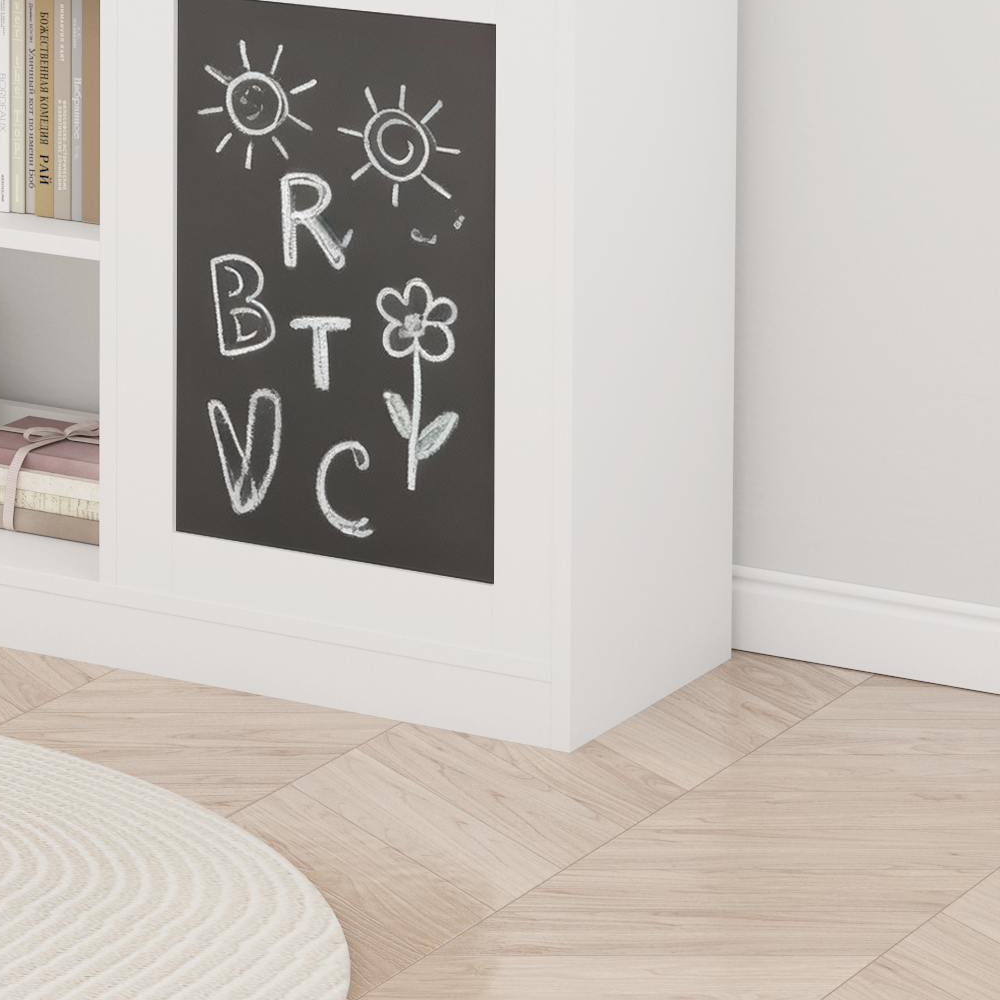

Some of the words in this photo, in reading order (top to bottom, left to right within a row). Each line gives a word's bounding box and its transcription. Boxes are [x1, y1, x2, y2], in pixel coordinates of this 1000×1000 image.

[39, 11, 49, 93] БОЖЕСТВЕННАЯ
[0, 72, 7, 132] BORDEAUX
[29, 118, 33, 131] по
[39, 96, 49, 145] КОМЕДИЯ
[72, 77, 82, 139] Избранное
[39, 154, 52, 185] РАЙ
[280, 172, 348, 270] R
[210, 253, 276, 357] B
[290, 316, 351, 391] T
[207, 387, 282, 514] V
[316, 440, 373, 538] C
